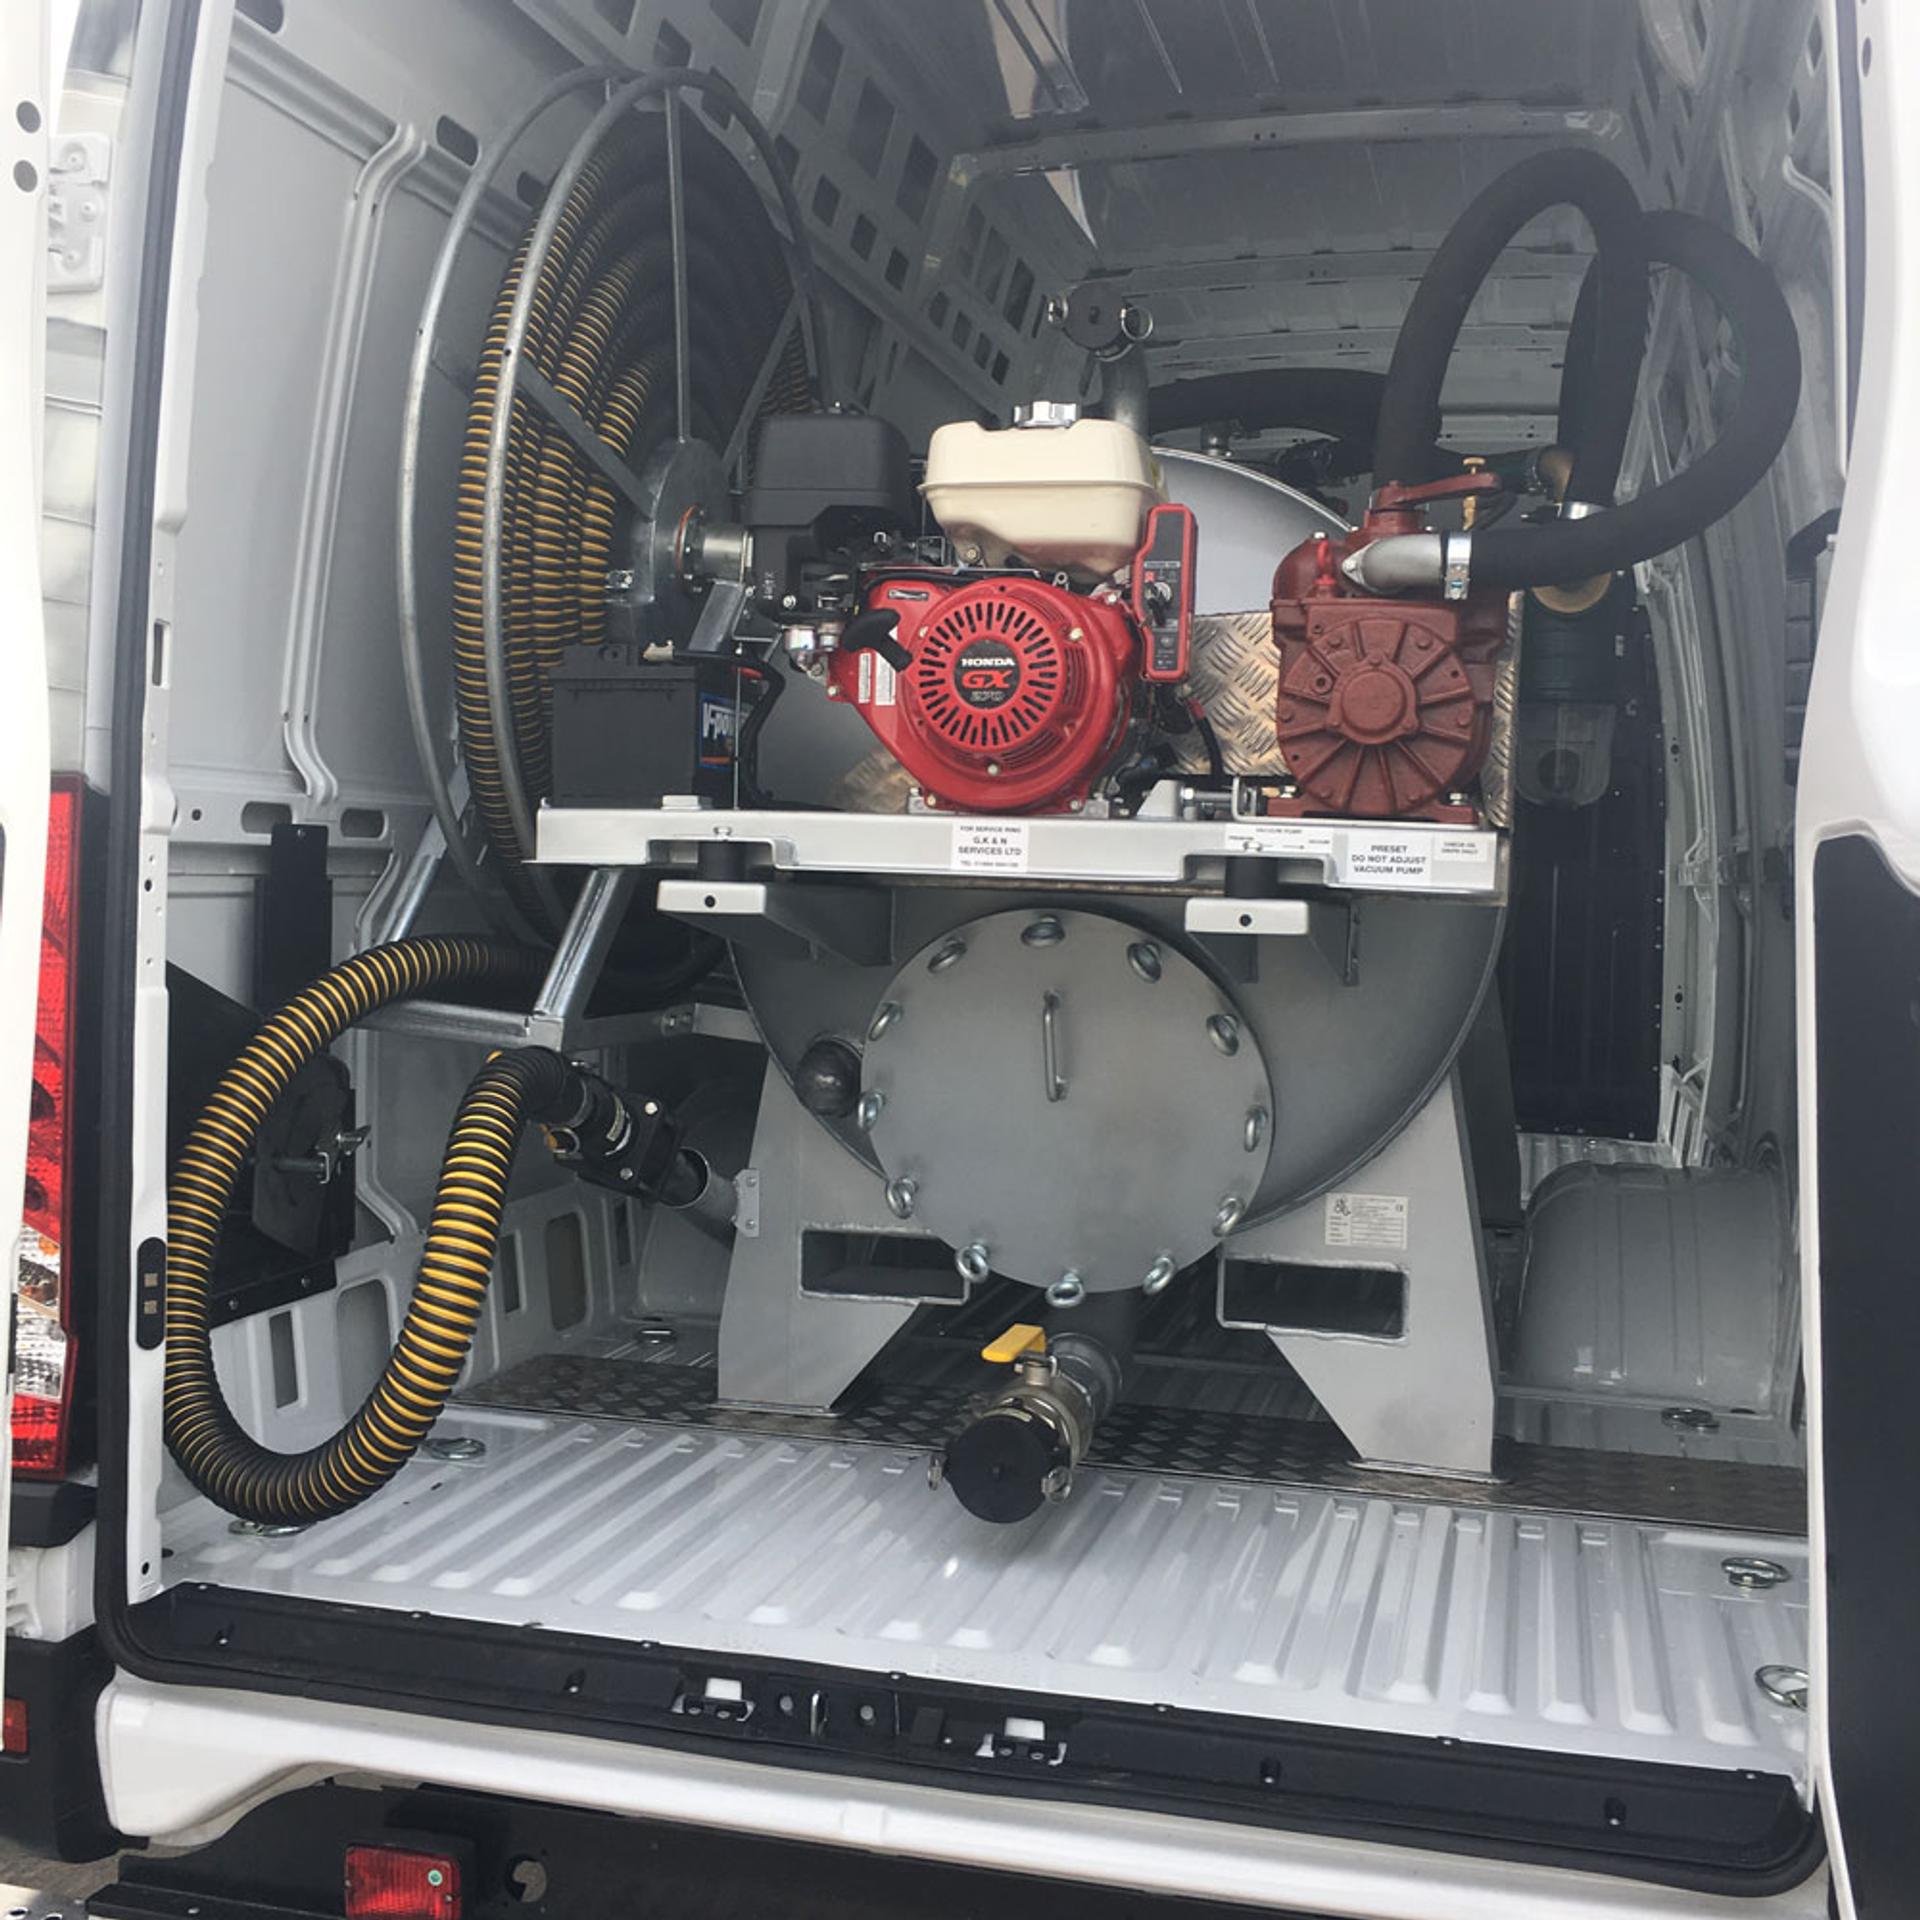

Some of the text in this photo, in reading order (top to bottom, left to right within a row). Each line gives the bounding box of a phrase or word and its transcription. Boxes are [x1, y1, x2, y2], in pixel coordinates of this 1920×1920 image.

[961, 657, 1016, 667] HONDA
[962, 670, 1013, 688] GX
[958, 847, 1022, 856] SERVICES LTD
[1371, 845, 1408, 853] PRESET
[1367, 855, 1387, 863] NOT
[1390, 856, 1426, 864] ADJUST
